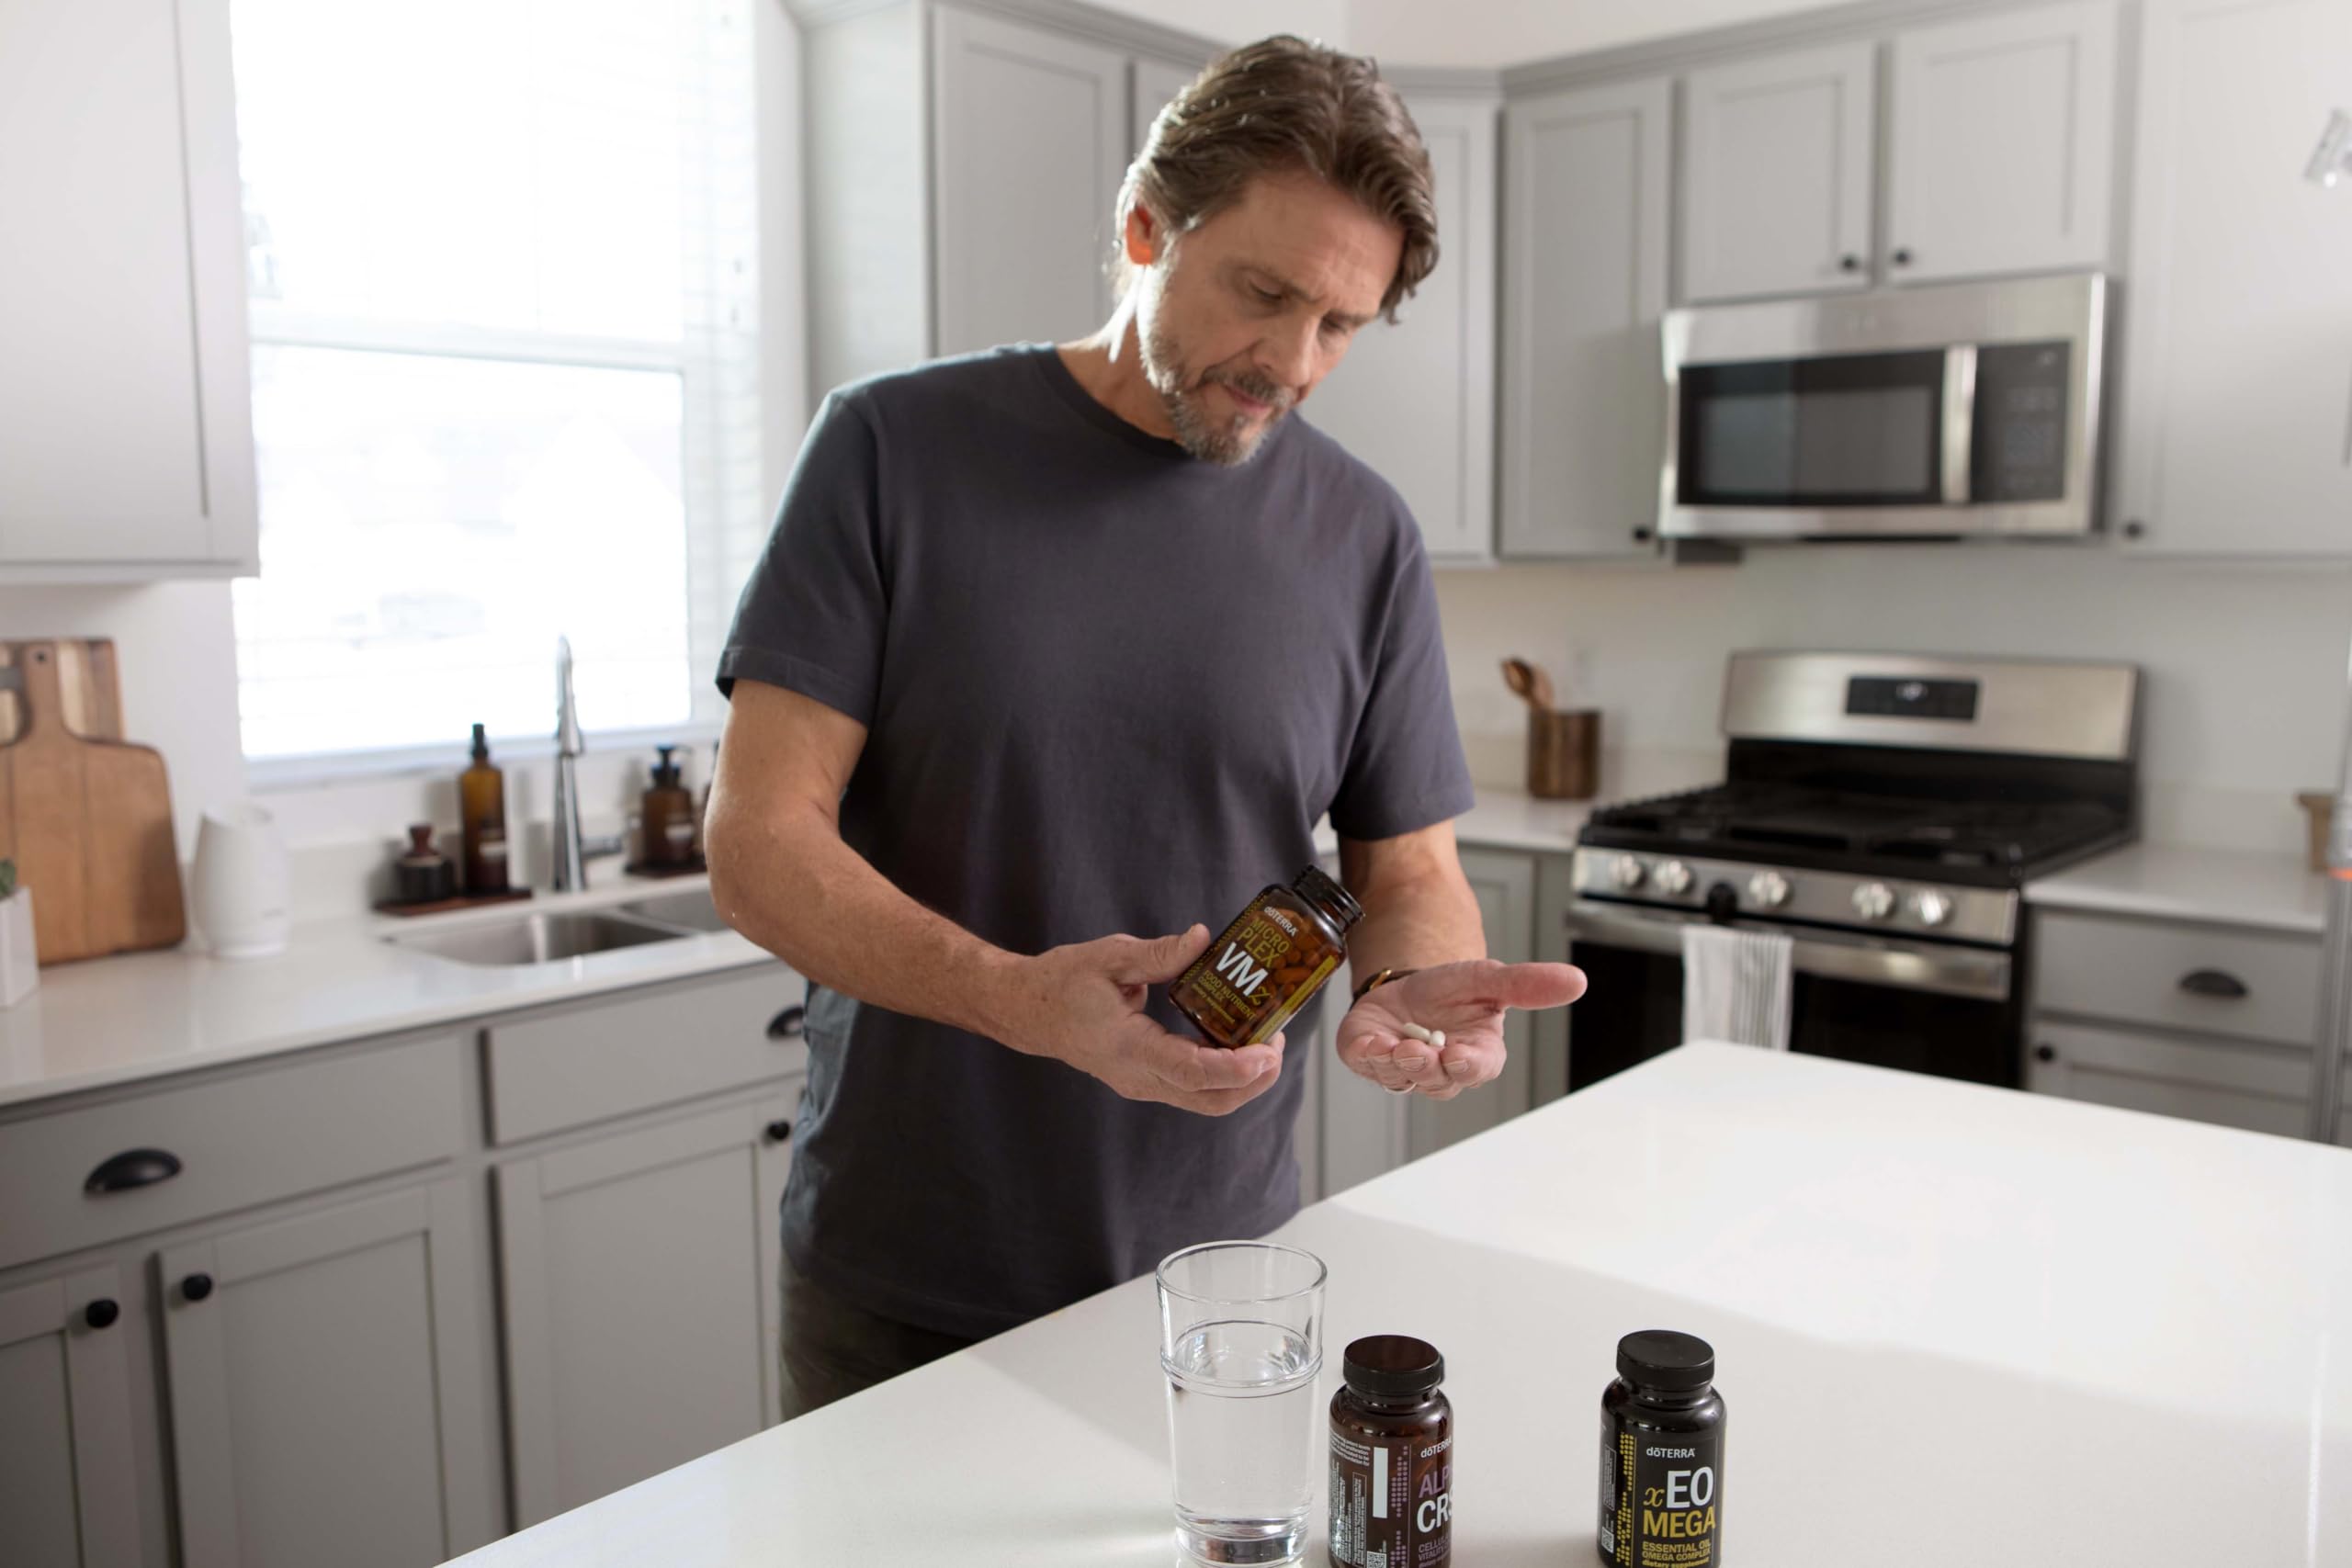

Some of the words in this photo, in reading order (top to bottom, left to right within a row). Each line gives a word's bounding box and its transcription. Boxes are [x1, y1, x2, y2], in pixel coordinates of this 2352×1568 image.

[1238, 928, 1282, 969] PLEX
[1249, 919, 1289, 953] MICRO
[1197, 976, 1225, 1002] COMPLEX
[1204, 969, 1223, 989] FOOD
[1221, 986, 1257, 1021] NUTRIENT
[1419, 1464, 1452, 1498] ALP
[1642, 1506, 1716, 1538] MEGA
[1419, 1534, 1448, 1553] CELLU
[1642, 1540, 1697, 1553] ESSENTIAL
[1698, 1538, 1712, 1550] OIL
[1642, 1551, 1675, 1562] OMEGA
[1676, 1547, 1711, 1562] COMPLEX
[1642, 1559, 1670, 1568] dietary
